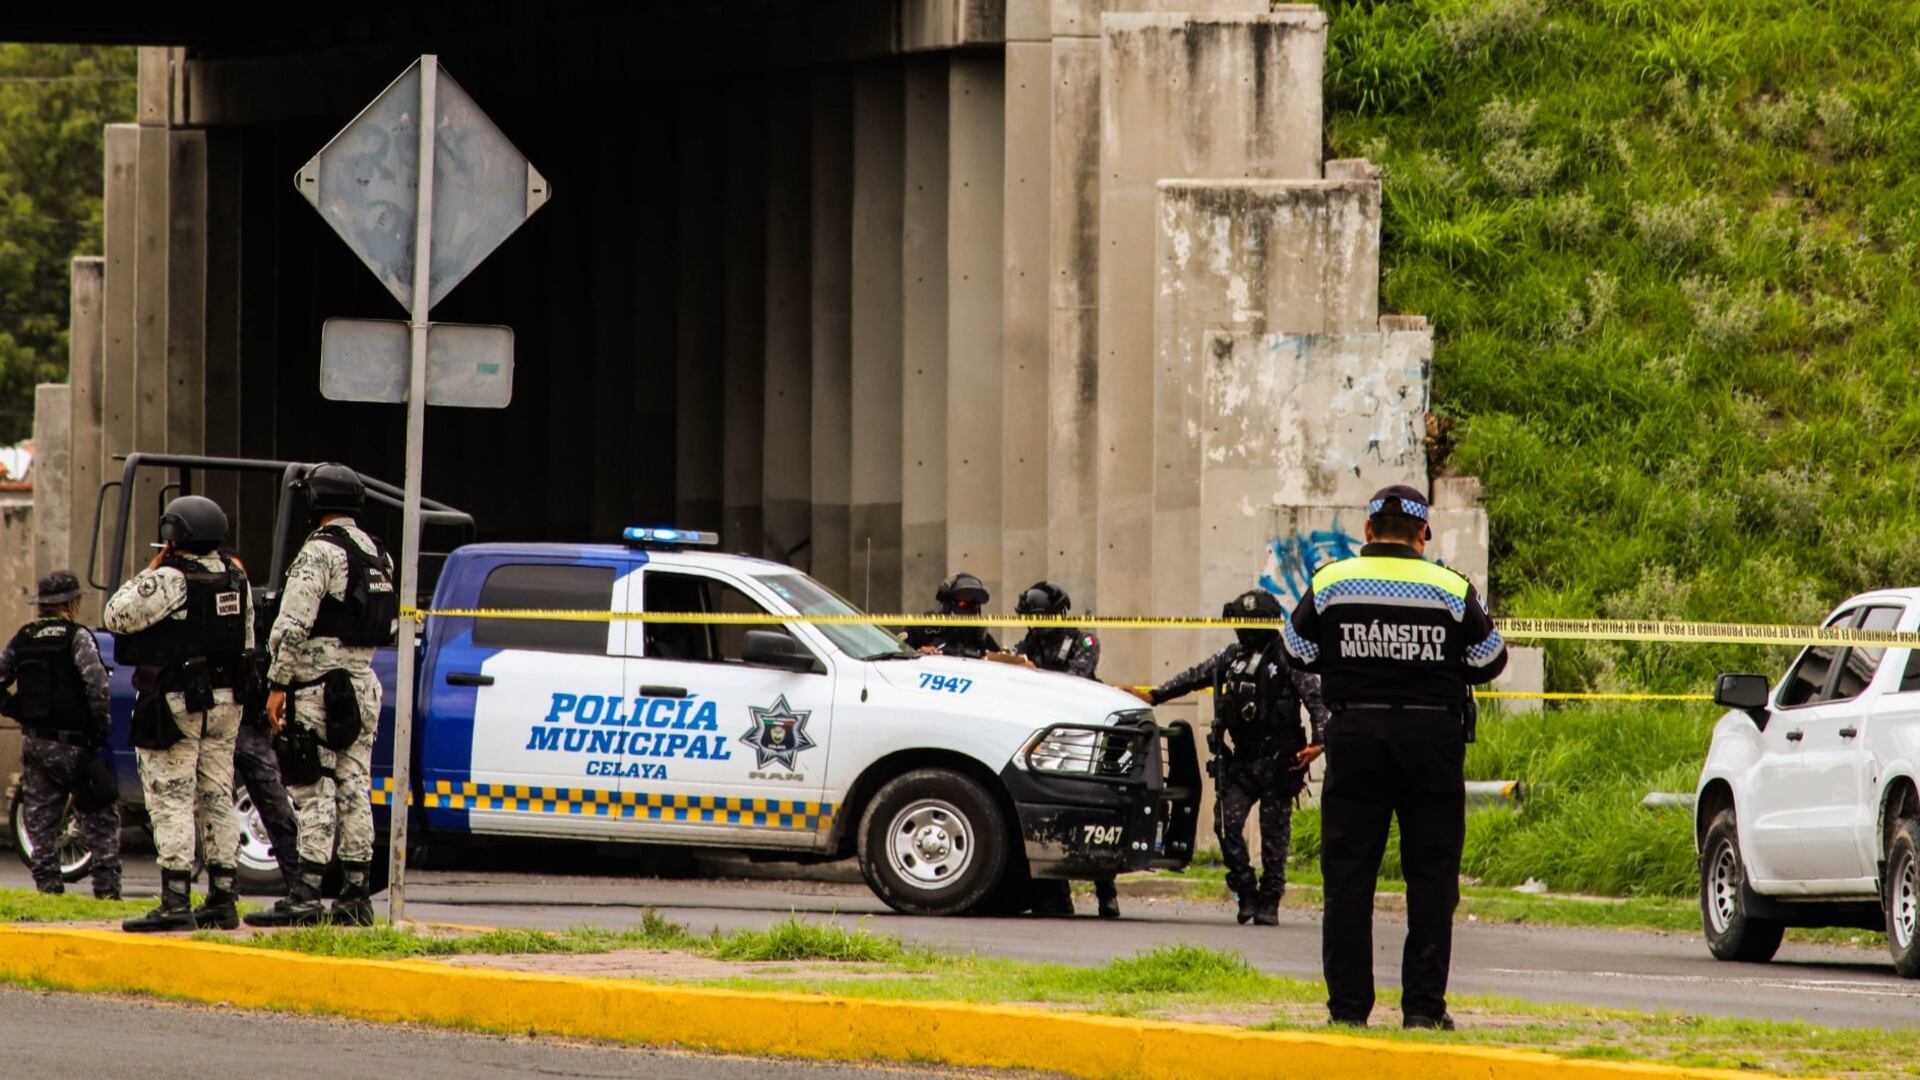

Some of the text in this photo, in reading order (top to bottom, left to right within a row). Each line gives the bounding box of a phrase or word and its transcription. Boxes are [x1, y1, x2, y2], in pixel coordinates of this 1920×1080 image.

[1340, 619, 1446, 643] TRÁNSITO
[1510, 619, 1532, 631] PASO
[1535, 620, 1542, 632] EL
[1544, 620, 1590, 633] PROHIBIDO
[1591, 621, 1624, 633] POLICIA
[1625, 622, 1636, 633] DE
[1637, 623, 1660, 634] LINEA
[1664, 623, 1685, 635] PASO
[1688, 623, 1696, 635] EL
[1697, 624, 1743, 637] PROHIBIDO
[1745, 625, 1777, 637] POLICIA
[1780, 626, 1789, 638] DE
[1818, 627, 1840, 639] PASO
[1842, 628, 1850, 640] EL
[1851, 629, 1898, 641] PROHIBIDO
[1899, 631, 1920, 642] ICIA
[1340, 641, 1445, 661] MUNICIPAL
[919, 672, 973, 693] 7947
[545, 692, 718, 731] POLICÍA
[525, 727, 732, 761] MUNICIPAL
[585, 760, 668, 780] CELAYA
[748, 771, 804, 782] RAM
[1083, 825, 1123, 844] 7947
